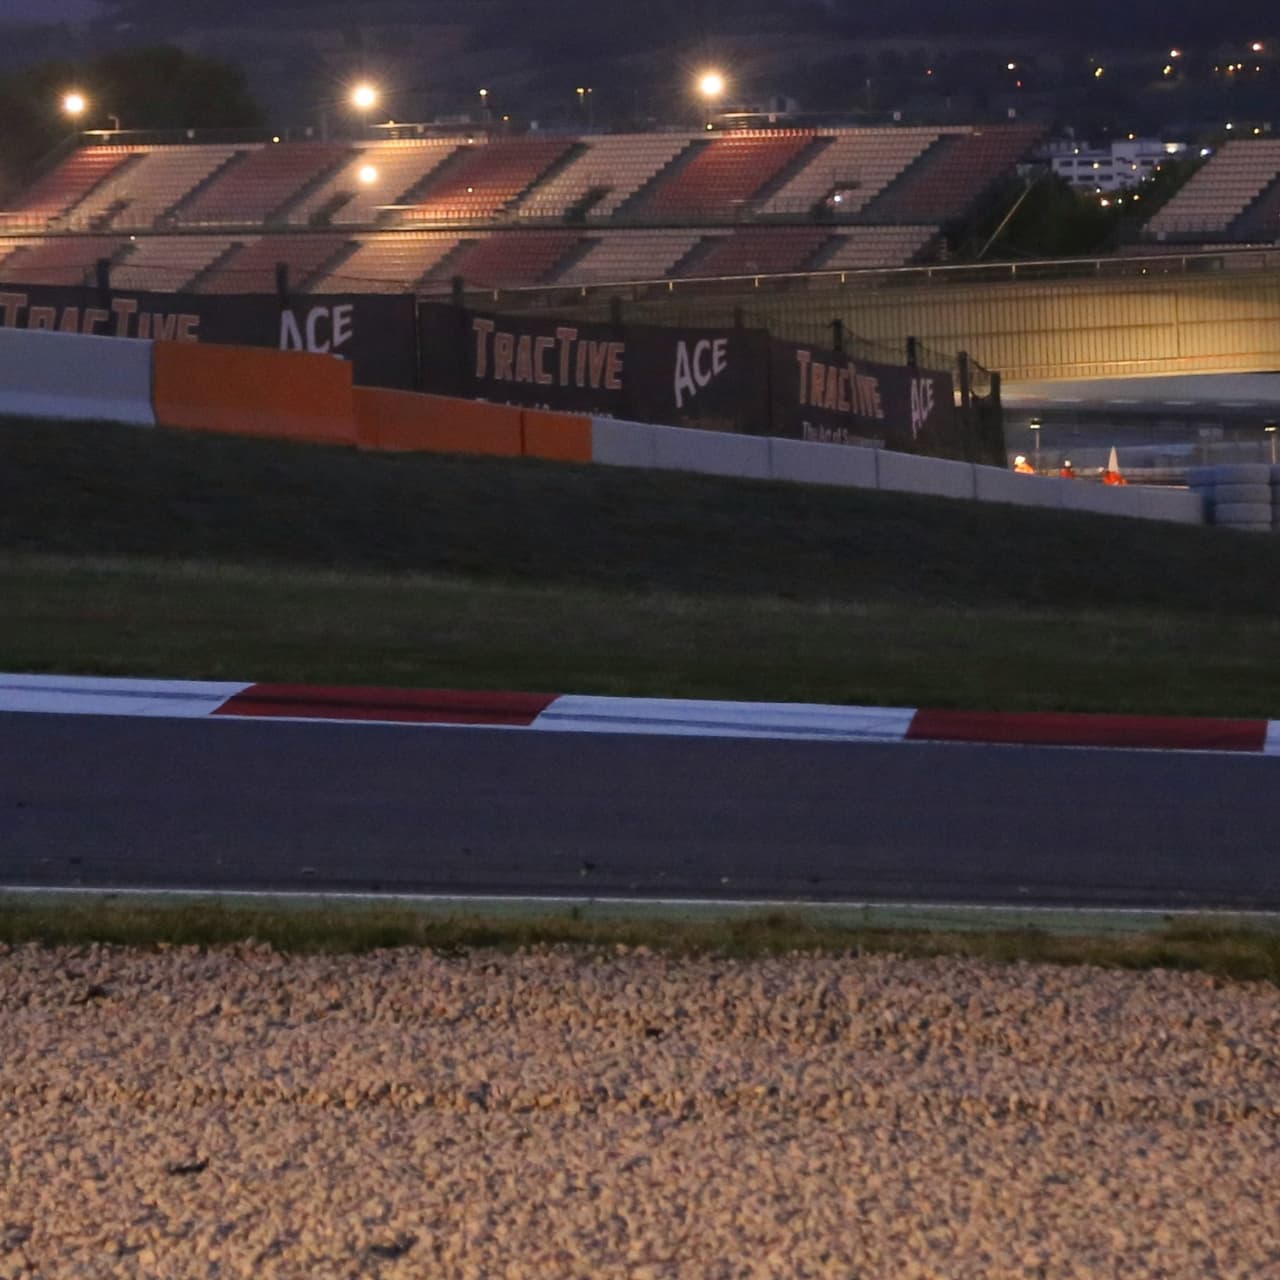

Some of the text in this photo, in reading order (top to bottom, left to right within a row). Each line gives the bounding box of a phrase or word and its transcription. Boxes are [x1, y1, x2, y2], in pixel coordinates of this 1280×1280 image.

[280, 304, 354, 353] ACE
[472, 318, 625, 390] TRACTIVE
[674, 338, 728, 408] ACE
[911, 377, 934, 440] ACE
